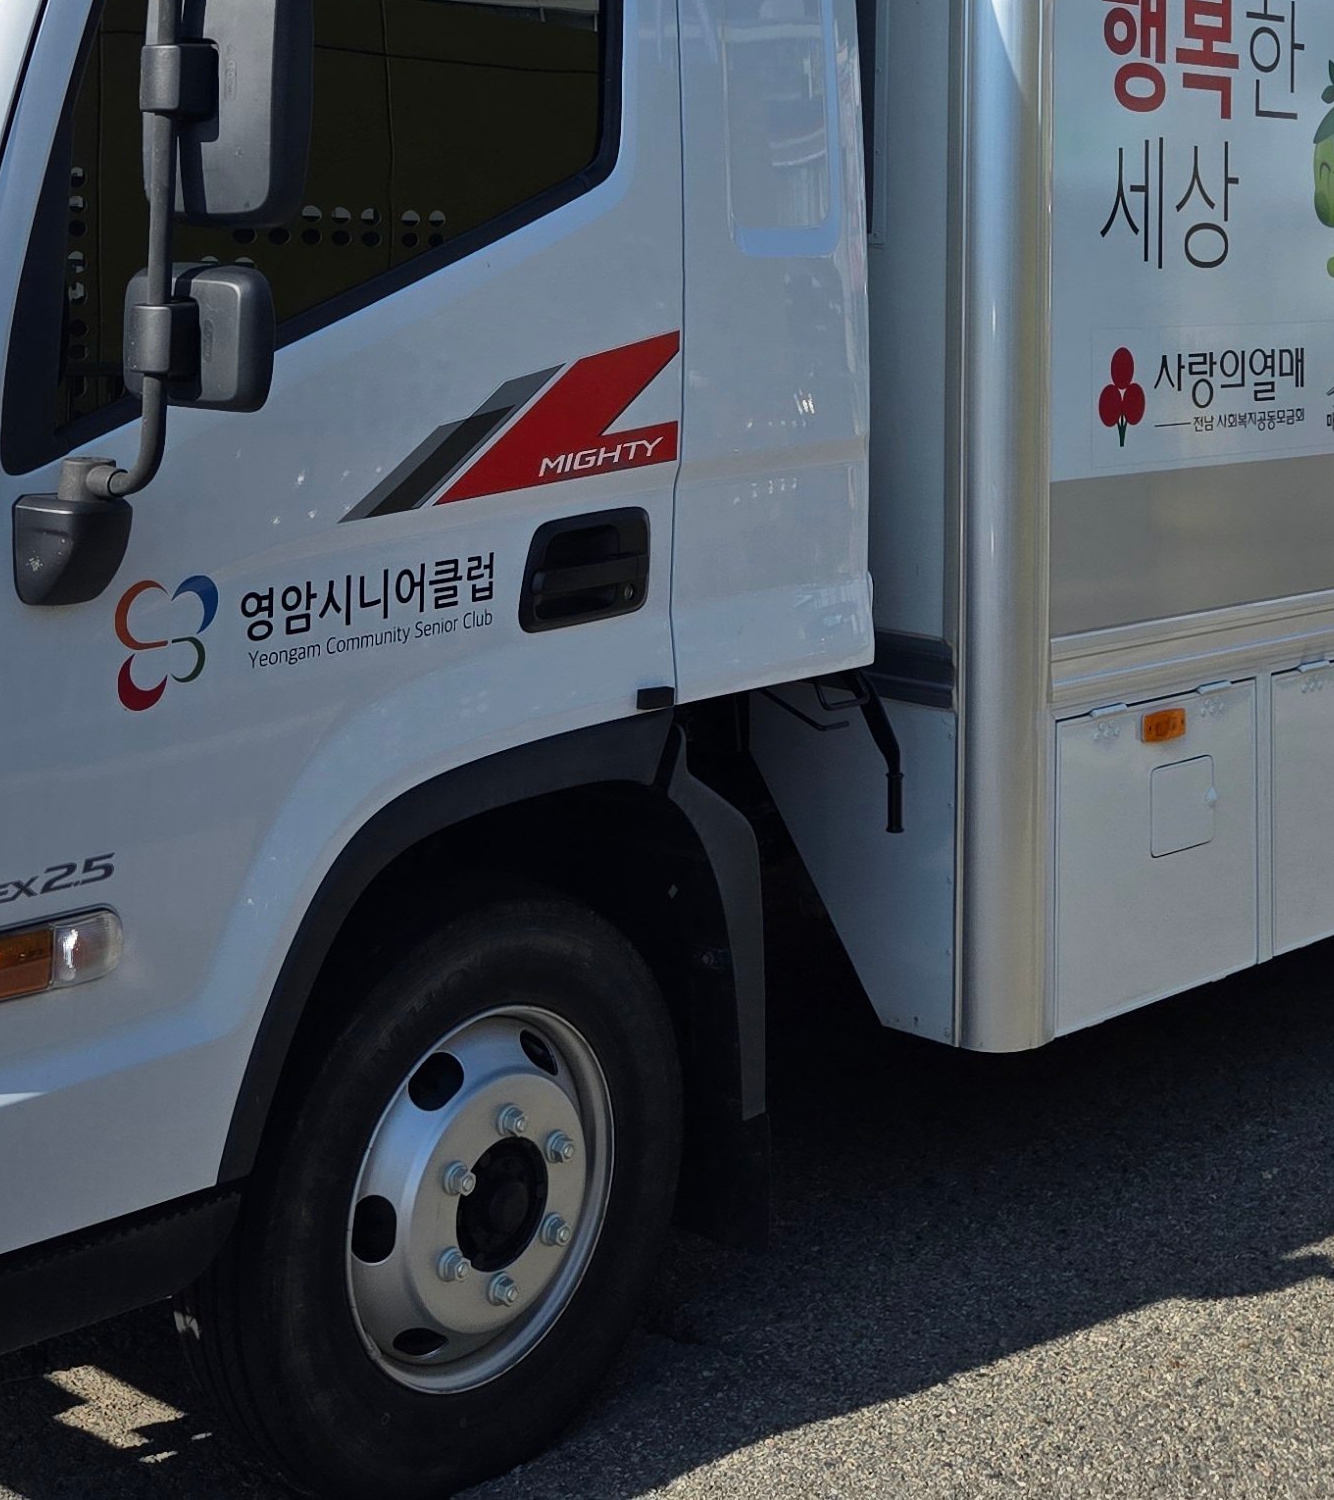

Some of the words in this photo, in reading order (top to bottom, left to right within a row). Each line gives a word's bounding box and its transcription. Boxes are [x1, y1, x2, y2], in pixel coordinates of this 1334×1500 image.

[1100, 137, 1240, 269] 세상
[1154, 347, 1306, 408] 사랑의열매
[1193, 415, 1214, 432] 전남
[1216, 407, 1305, 431] 사회복지공동모금회
[538, 436, 663, 477] MIGHTY
[241, 552, 495, 641] 영암시니어클럽
[248, 643, 321, 669] Yeongam
[326, 626, 410, 655] Community
[415, 616, 458, 638] Senior
[463, 609, 493, 630] Club
